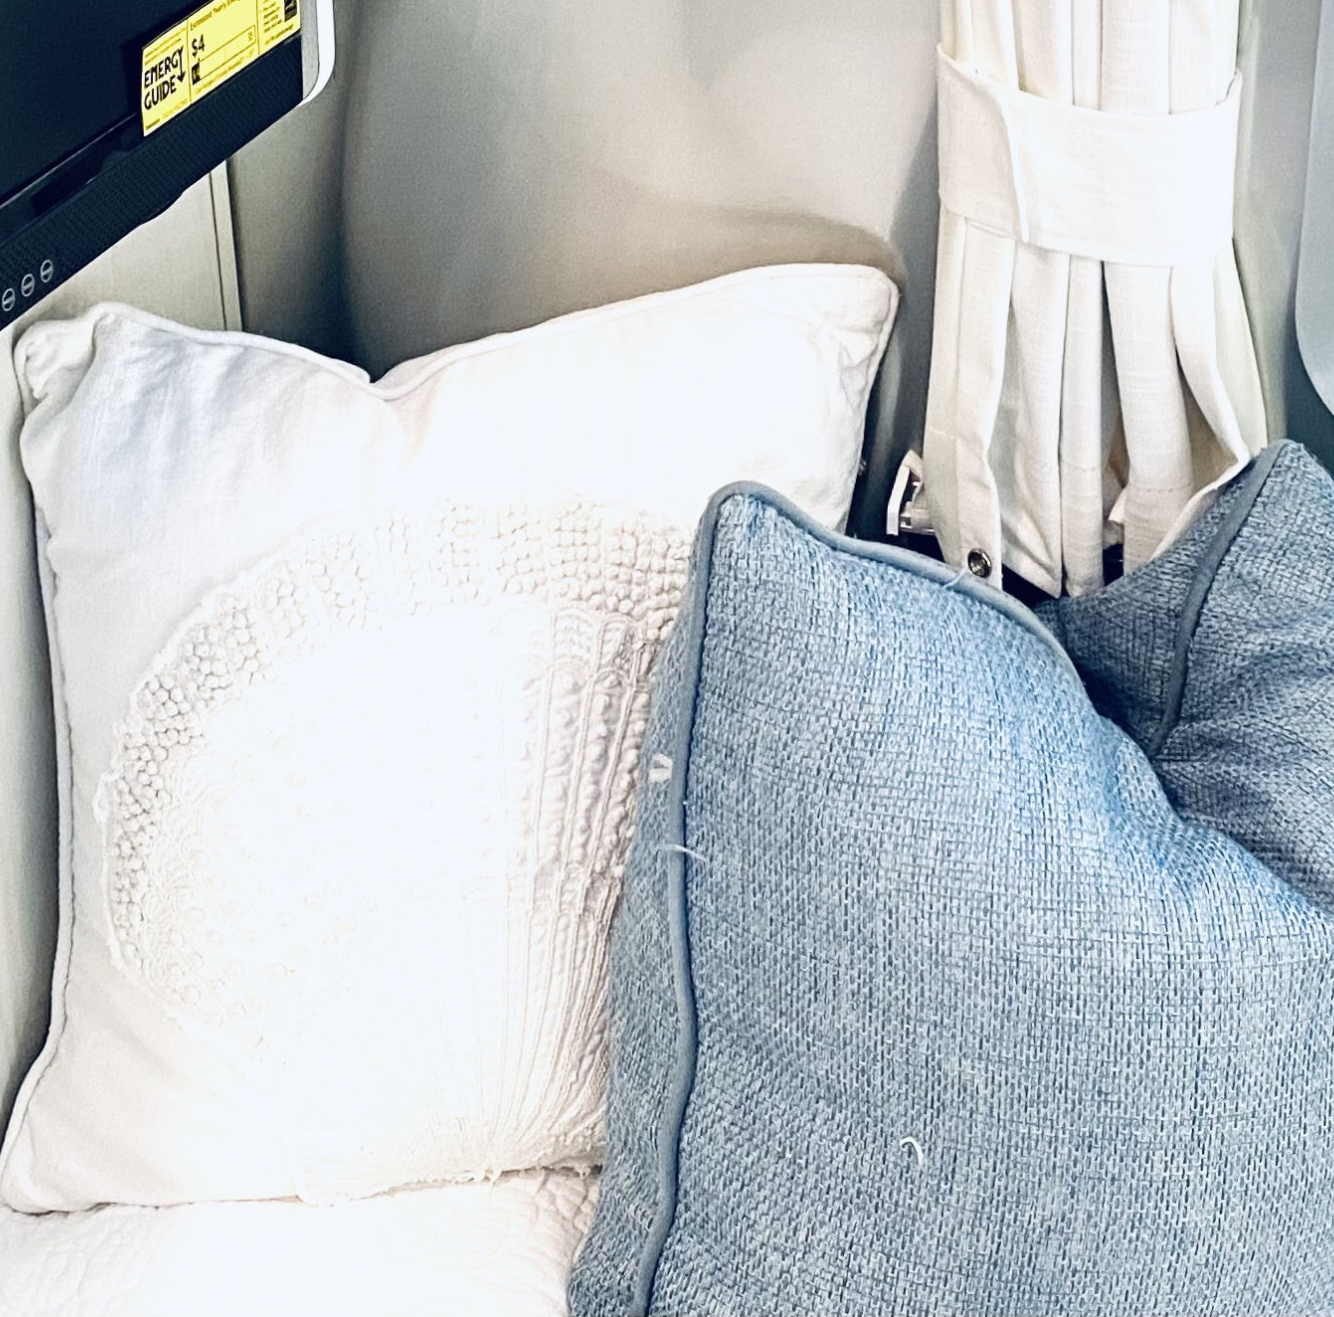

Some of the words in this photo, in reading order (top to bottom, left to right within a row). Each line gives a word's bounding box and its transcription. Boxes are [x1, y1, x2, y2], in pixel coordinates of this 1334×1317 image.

[191, 33, 205, 57] $4
[144, 45, 185, 88] ENERGY
[144, 74, 177, 110] GUIDE
